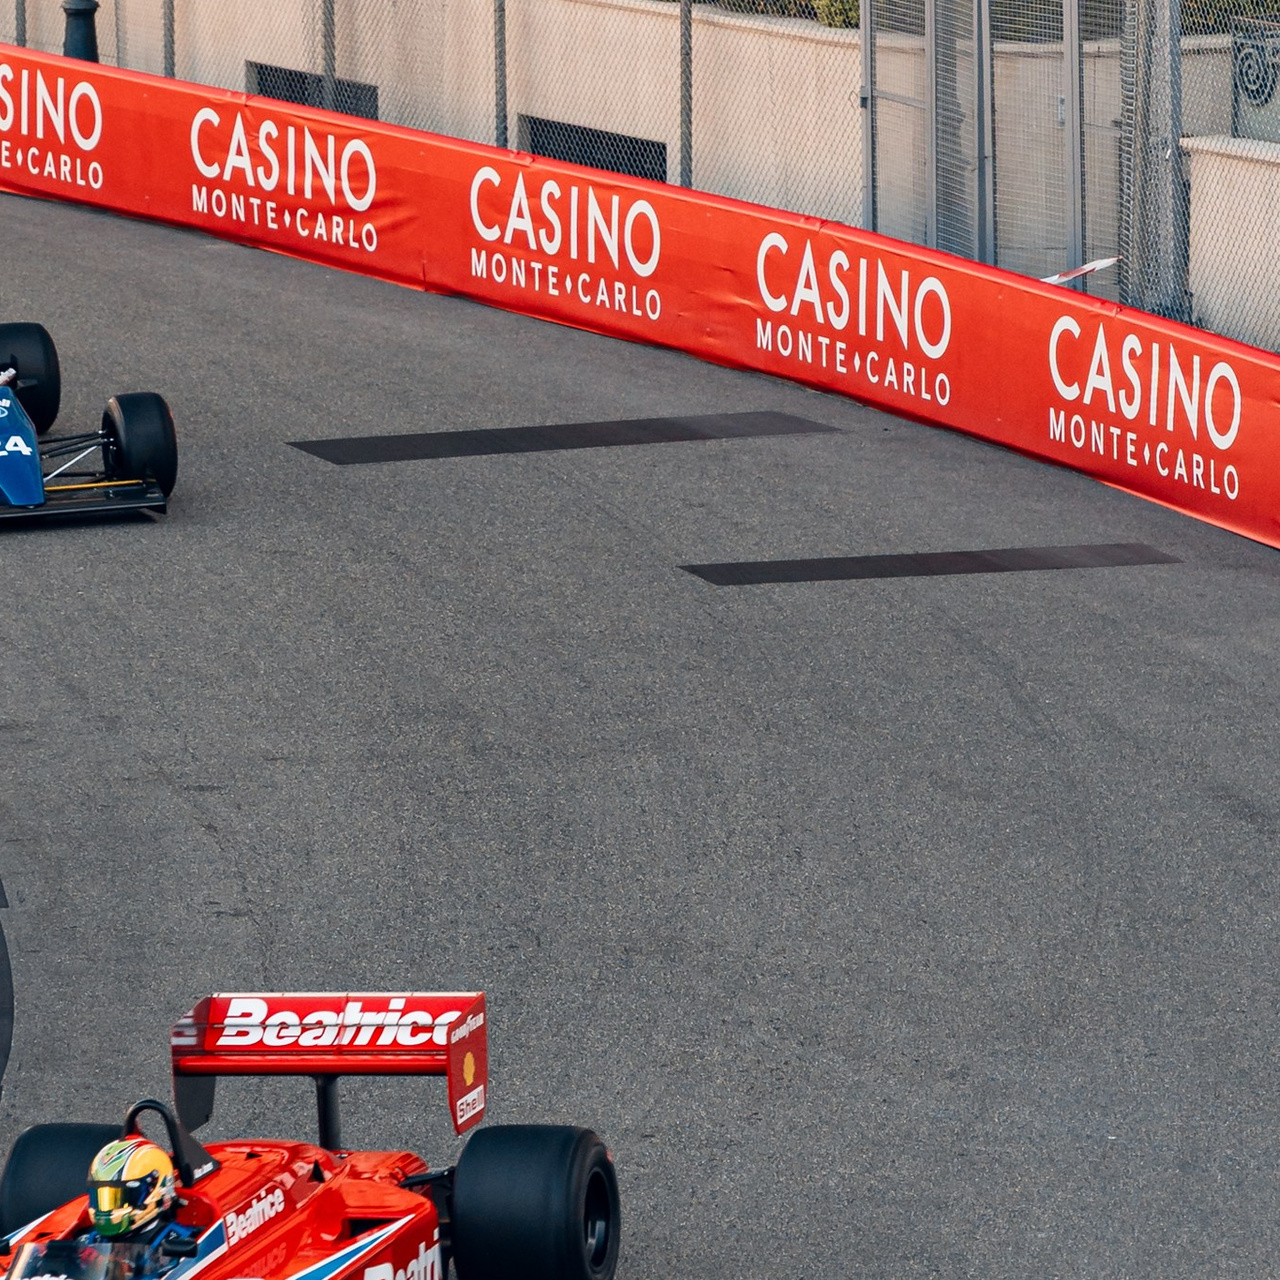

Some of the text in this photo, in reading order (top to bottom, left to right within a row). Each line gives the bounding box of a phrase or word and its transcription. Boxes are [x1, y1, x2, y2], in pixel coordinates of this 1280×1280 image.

[28, 147, 102, 189] CARLO
[191, 108, 376, 213] CASINO
[193, 185, 377, 251] MONTE CARLO
[470, 167, 660, 279] CASINO
[472, 248, 660, 320] MONTE CARLO
[757, 233, 951, 361] CASINO
[757, 318, 950, 406] MONTE CARLO
[1049, 315, 1244, 452] CASINO
[1050, 408, 1238, 499] MONTE CARLO
[458, 1088, 484, 1120] Shell
[226, 1188, 285, 1246] Beatrice
